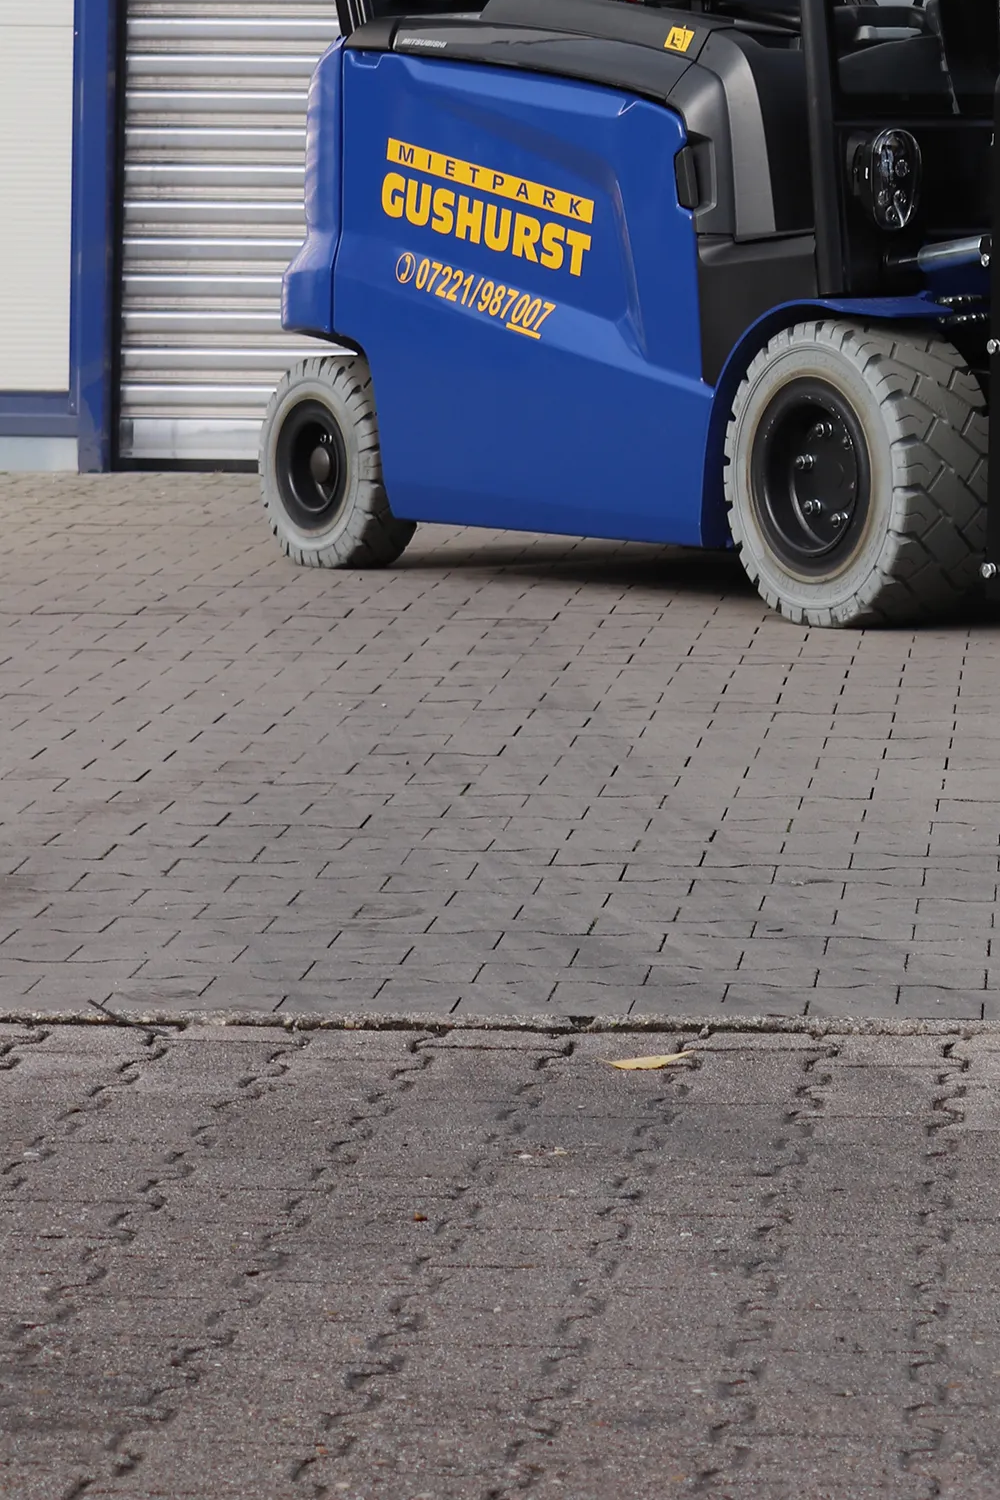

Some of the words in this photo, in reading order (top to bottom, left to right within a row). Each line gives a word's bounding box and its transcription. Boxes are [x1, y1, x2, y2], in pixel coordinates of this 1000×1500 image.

[401, 38, 448, 49] MITSUBISHI
[398, 145, 583, 216] MIETPARK
[381, 172, 591, 276] GUSHURST
[415, 258, 556, 332] 07221/987007
